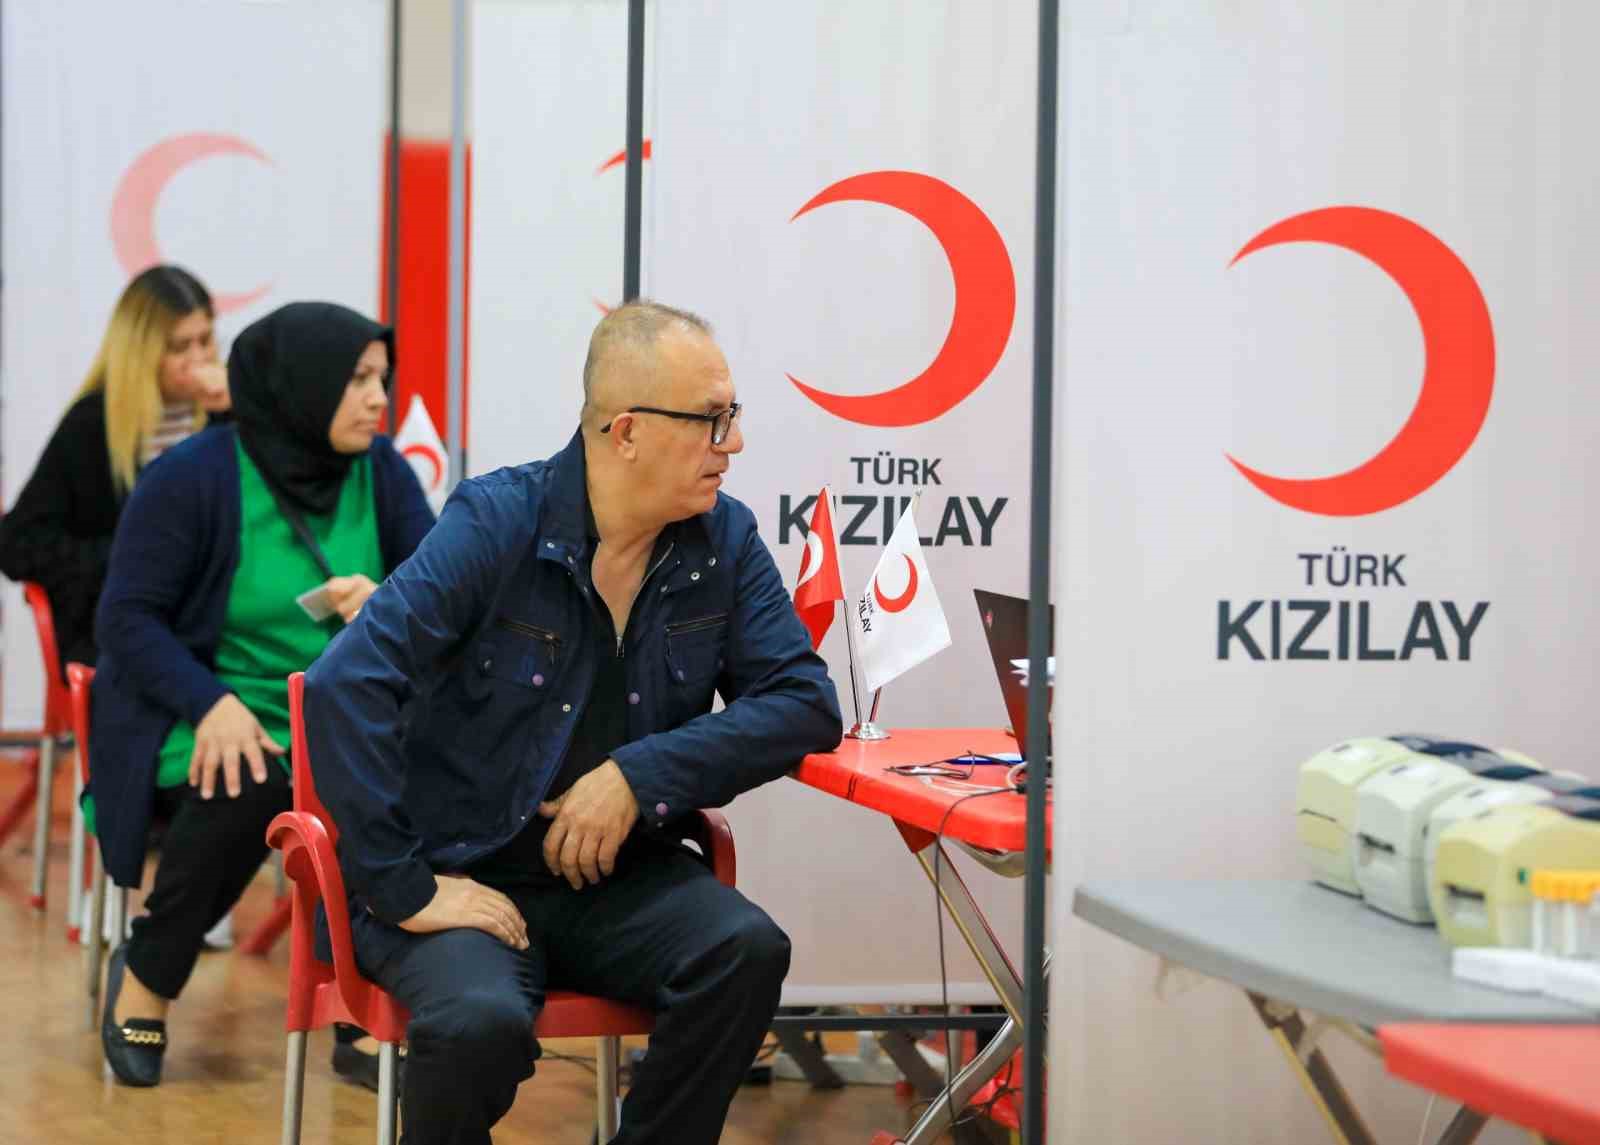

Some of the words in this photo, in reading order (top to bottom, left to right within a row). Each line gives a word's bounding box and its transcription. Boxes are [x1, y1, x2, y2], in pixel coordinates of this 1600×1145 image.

[850, 451, 942, 485] TÜRK
[778, 494, 1009, 547] KZIAY
[1298, 546, 1407, 587] TÜRK
[1217, 600, 1491, 661] KIZILAY
